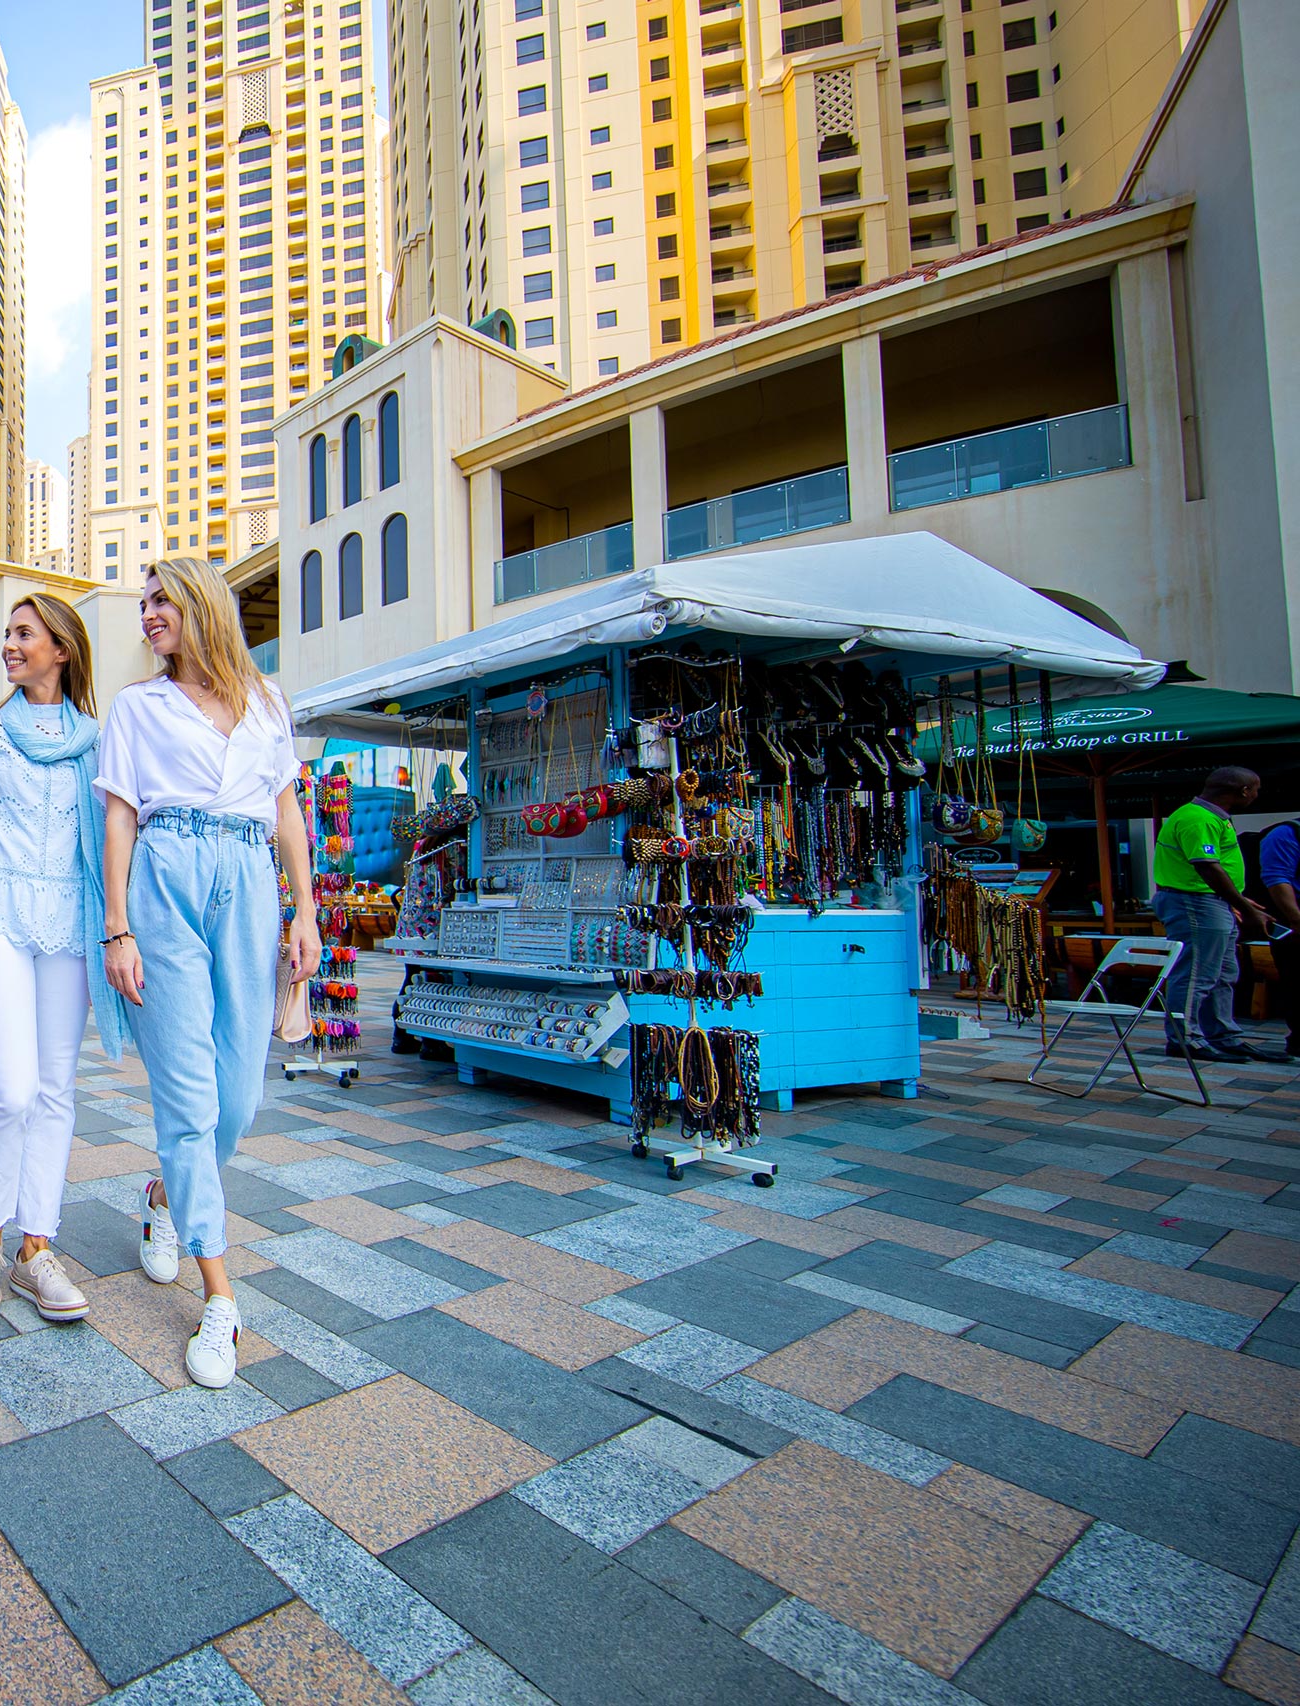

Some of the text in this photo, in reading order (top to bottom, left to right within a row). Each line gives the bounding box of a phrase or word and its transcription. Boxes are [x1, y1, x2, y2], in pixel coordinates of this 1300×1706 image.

[985, 738, 1052, 756] Butcher
[1052, 734, 1100, 753] Shop
[1103, 734, 1117, 745] &
[1121, 730, 1190, 744] GRILL
